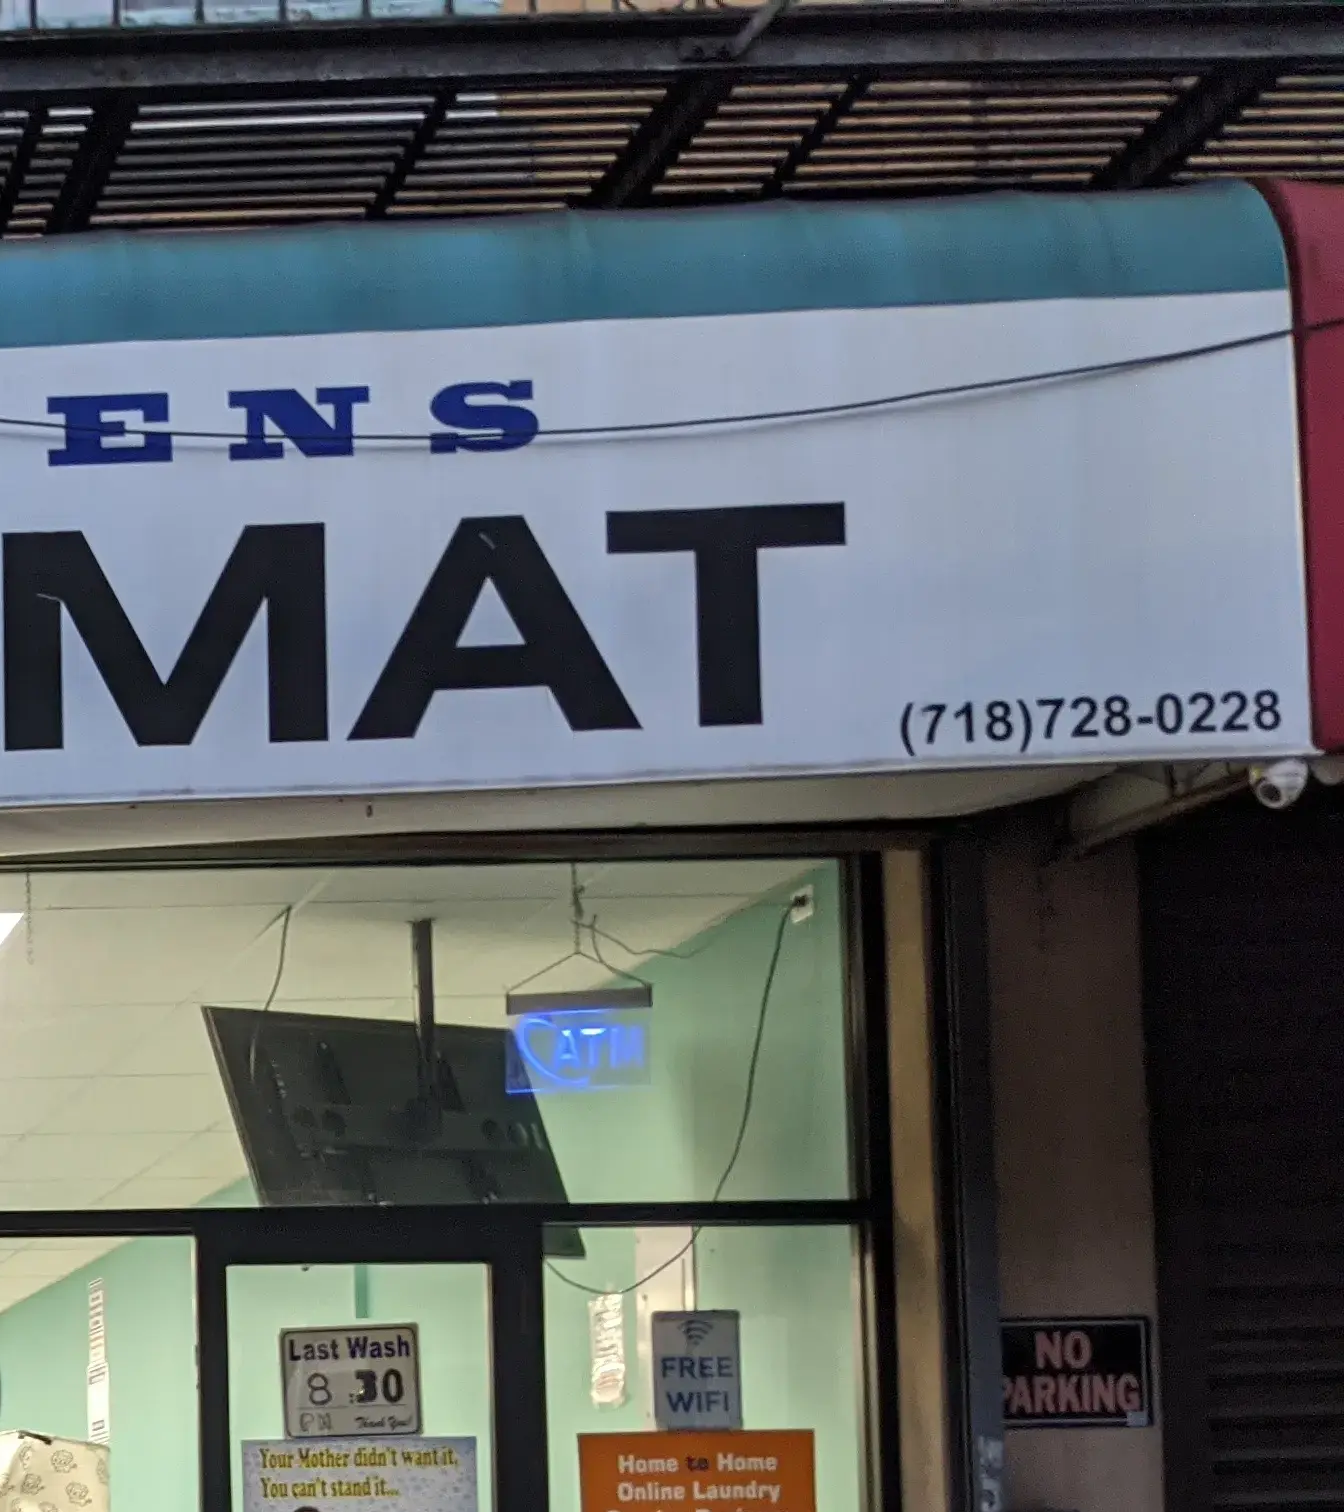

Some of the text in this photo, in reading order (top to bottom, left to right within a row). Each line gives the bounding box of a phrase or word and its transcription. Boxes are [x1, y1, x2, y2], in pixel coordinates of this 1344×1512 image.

[900, 690, 1283, 757] (718)728-0228
[288, 1334, 411, 1362] Last Wash
[1034, 1329, 1093, 1370] NO
[661, 1356, 733, 1379] FREE
[666, 1390, 729, 1413] WIFI
[260, 1448, 294, 1469] Your
[299, 1446, 351, 1469] Mother
[354, 1446, 398, 1468] didn't
[403, 1448, 439, 1468] want
[618, 1453, 778, 1474] Home to Home
[260, 1477, 288, 1498] You
[291, 1478, 328, 1499] can't
[332, 1478, 371, 1497] stand
[617, 1481, 781, 1503] Online Laundry
